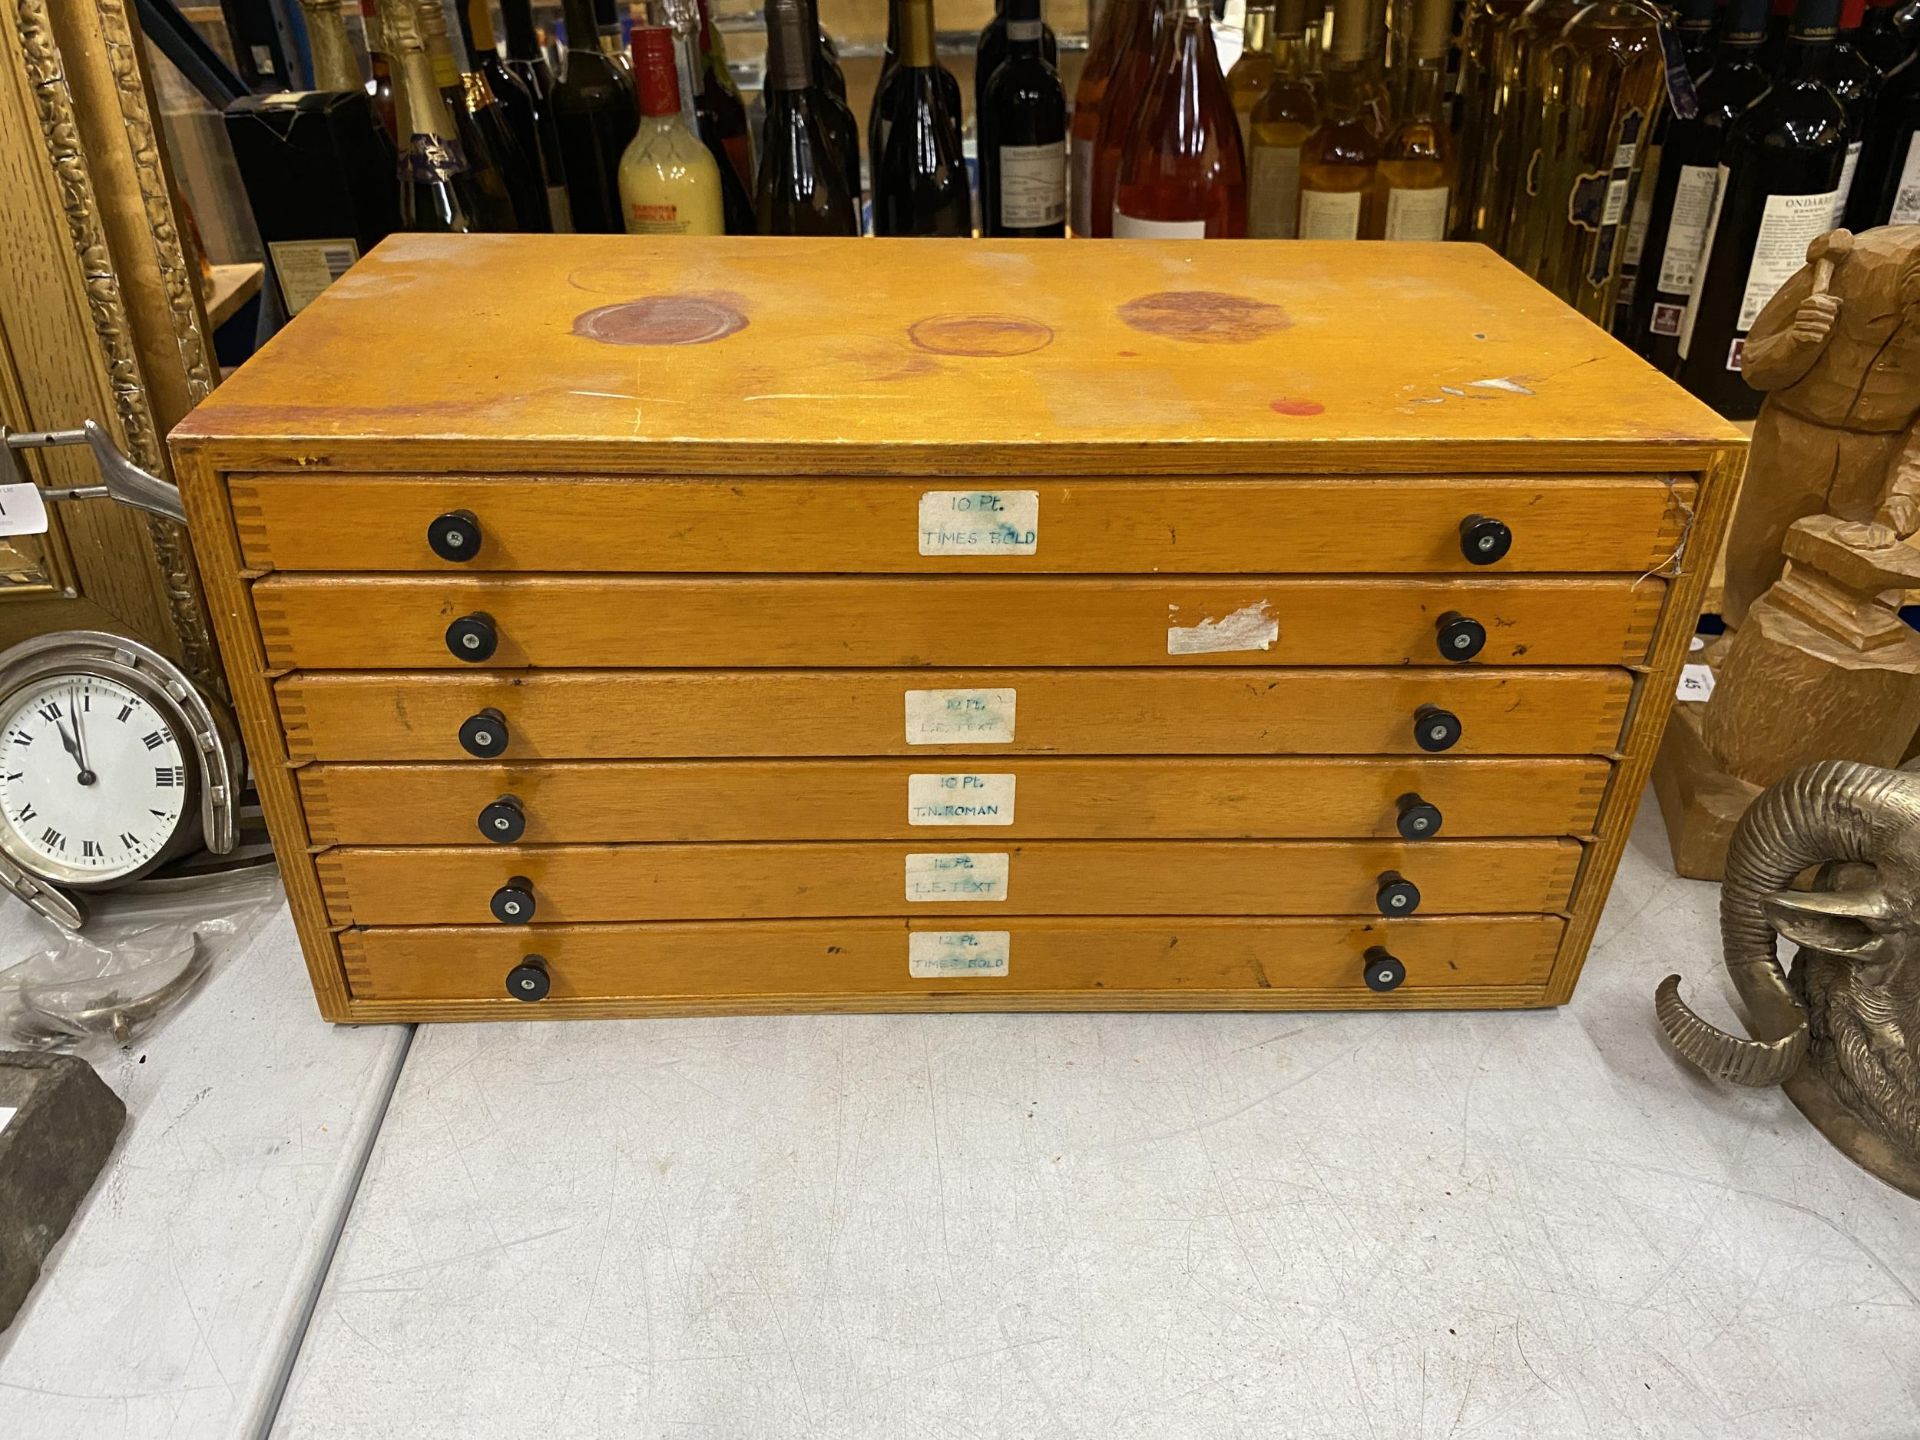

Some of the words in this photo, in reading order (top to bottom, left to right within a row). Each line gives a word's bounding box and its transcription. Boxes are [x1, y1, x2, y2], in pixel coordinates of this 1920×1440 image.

[951, 496, 971, 512] 10
[922, 531, 977, 544] TIMES
[1684, 677, 1701, 689] 45
[940, 777, 958, 789] 10
